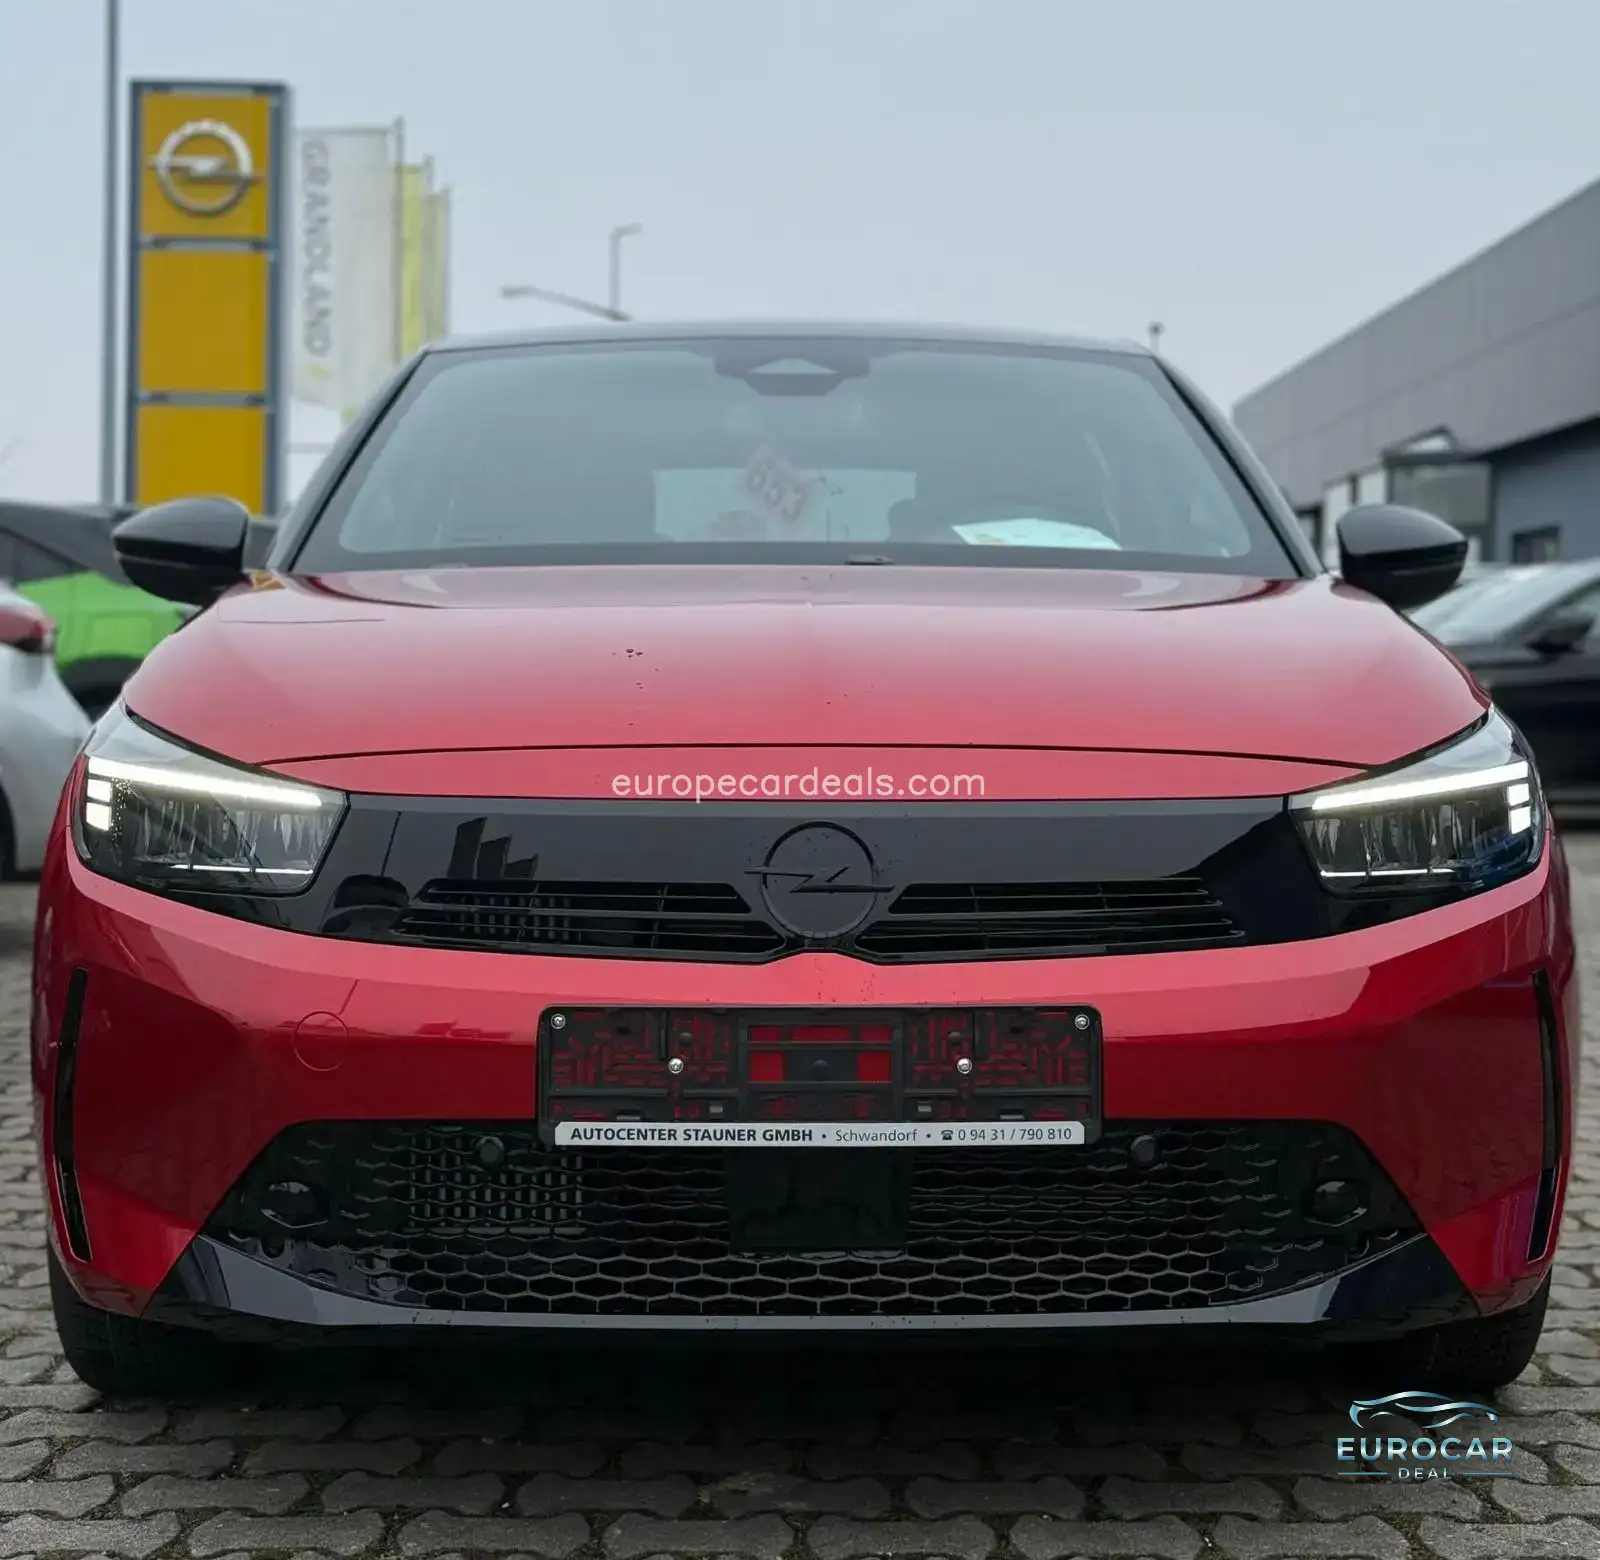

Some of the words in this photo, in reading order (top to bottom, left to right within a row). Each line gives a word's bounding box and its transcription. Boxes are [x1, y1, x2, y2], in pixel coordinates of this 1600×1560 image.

[570, 1127, 677, 1141] AUTOCENTER
[683, 1127, 756, 1142] STAUNER
[762, 1128, 813, 1142] GMBH
[835, 1129, 917, 1142] Schwandorf
[957, 1128, 966, 1141] 0
[969, 1128, 986, 1141] 94
[991, 1128, 1006, 1141] 31
[1019, 1127, 1043, 1141] 790
[1047, 1127, 1072, 1141] 810
